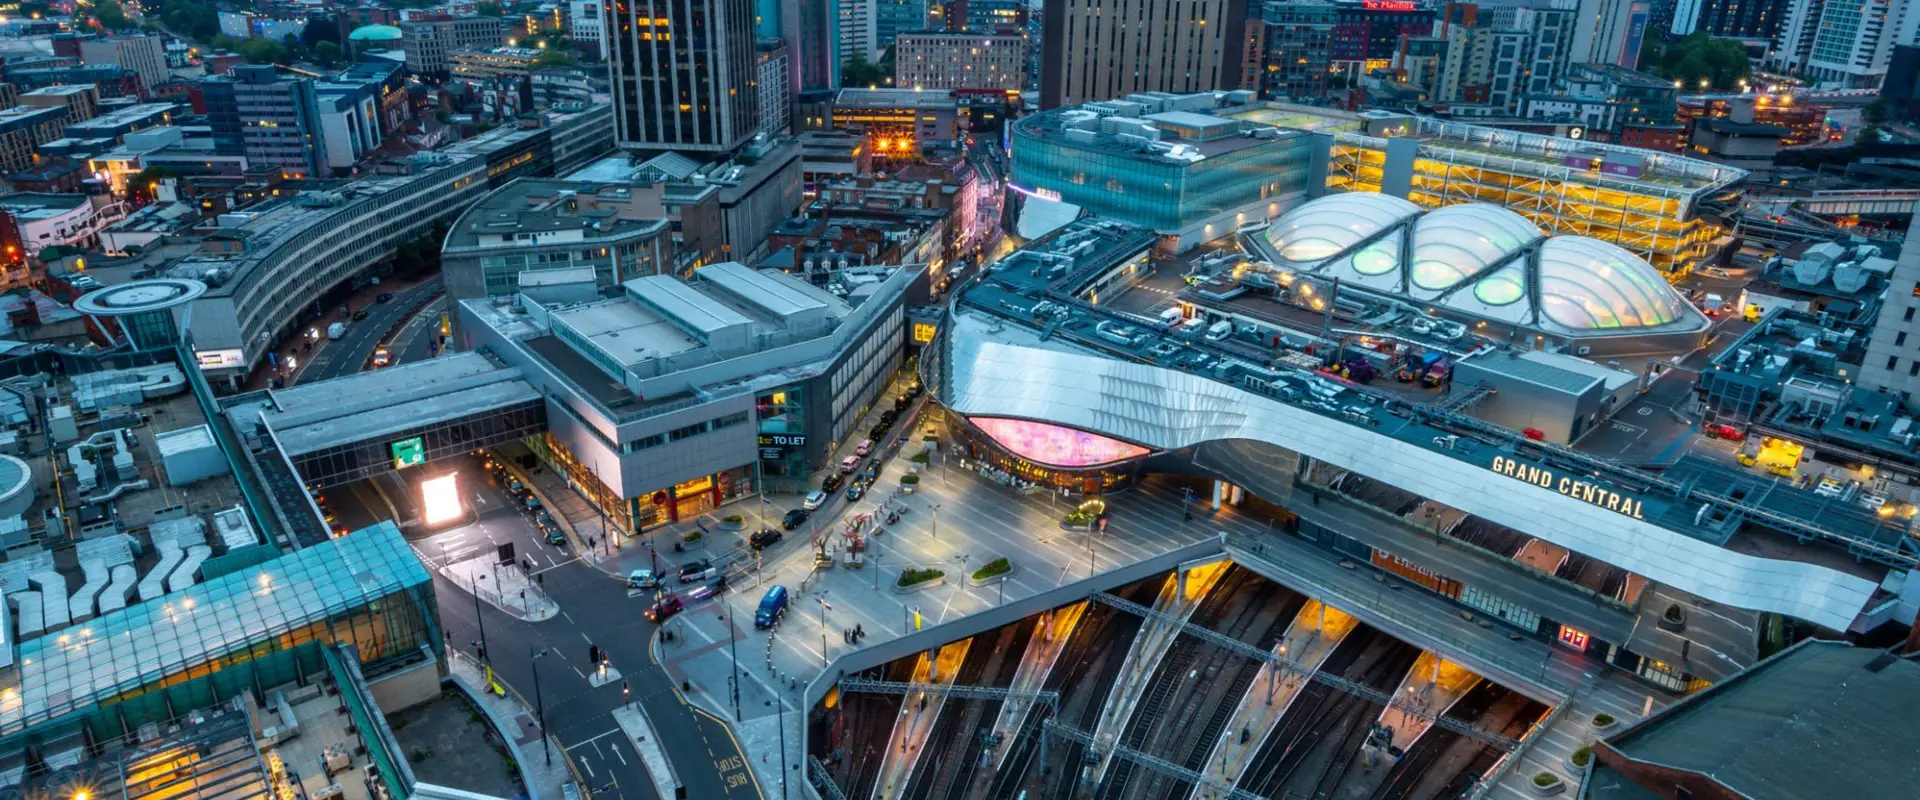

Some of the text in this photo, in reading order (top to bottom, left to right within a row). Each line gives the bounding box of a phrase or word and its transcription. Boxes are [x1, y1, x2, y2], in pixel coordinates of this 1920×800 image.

[773, 436, 787, 445] TO
[789, 436, 806, 446] LET
[1493, 455, 1644, 520] GRAND CENTRAL
[719, 755, 742, 773] STOP
[727, 772, 747, 788] BUS
